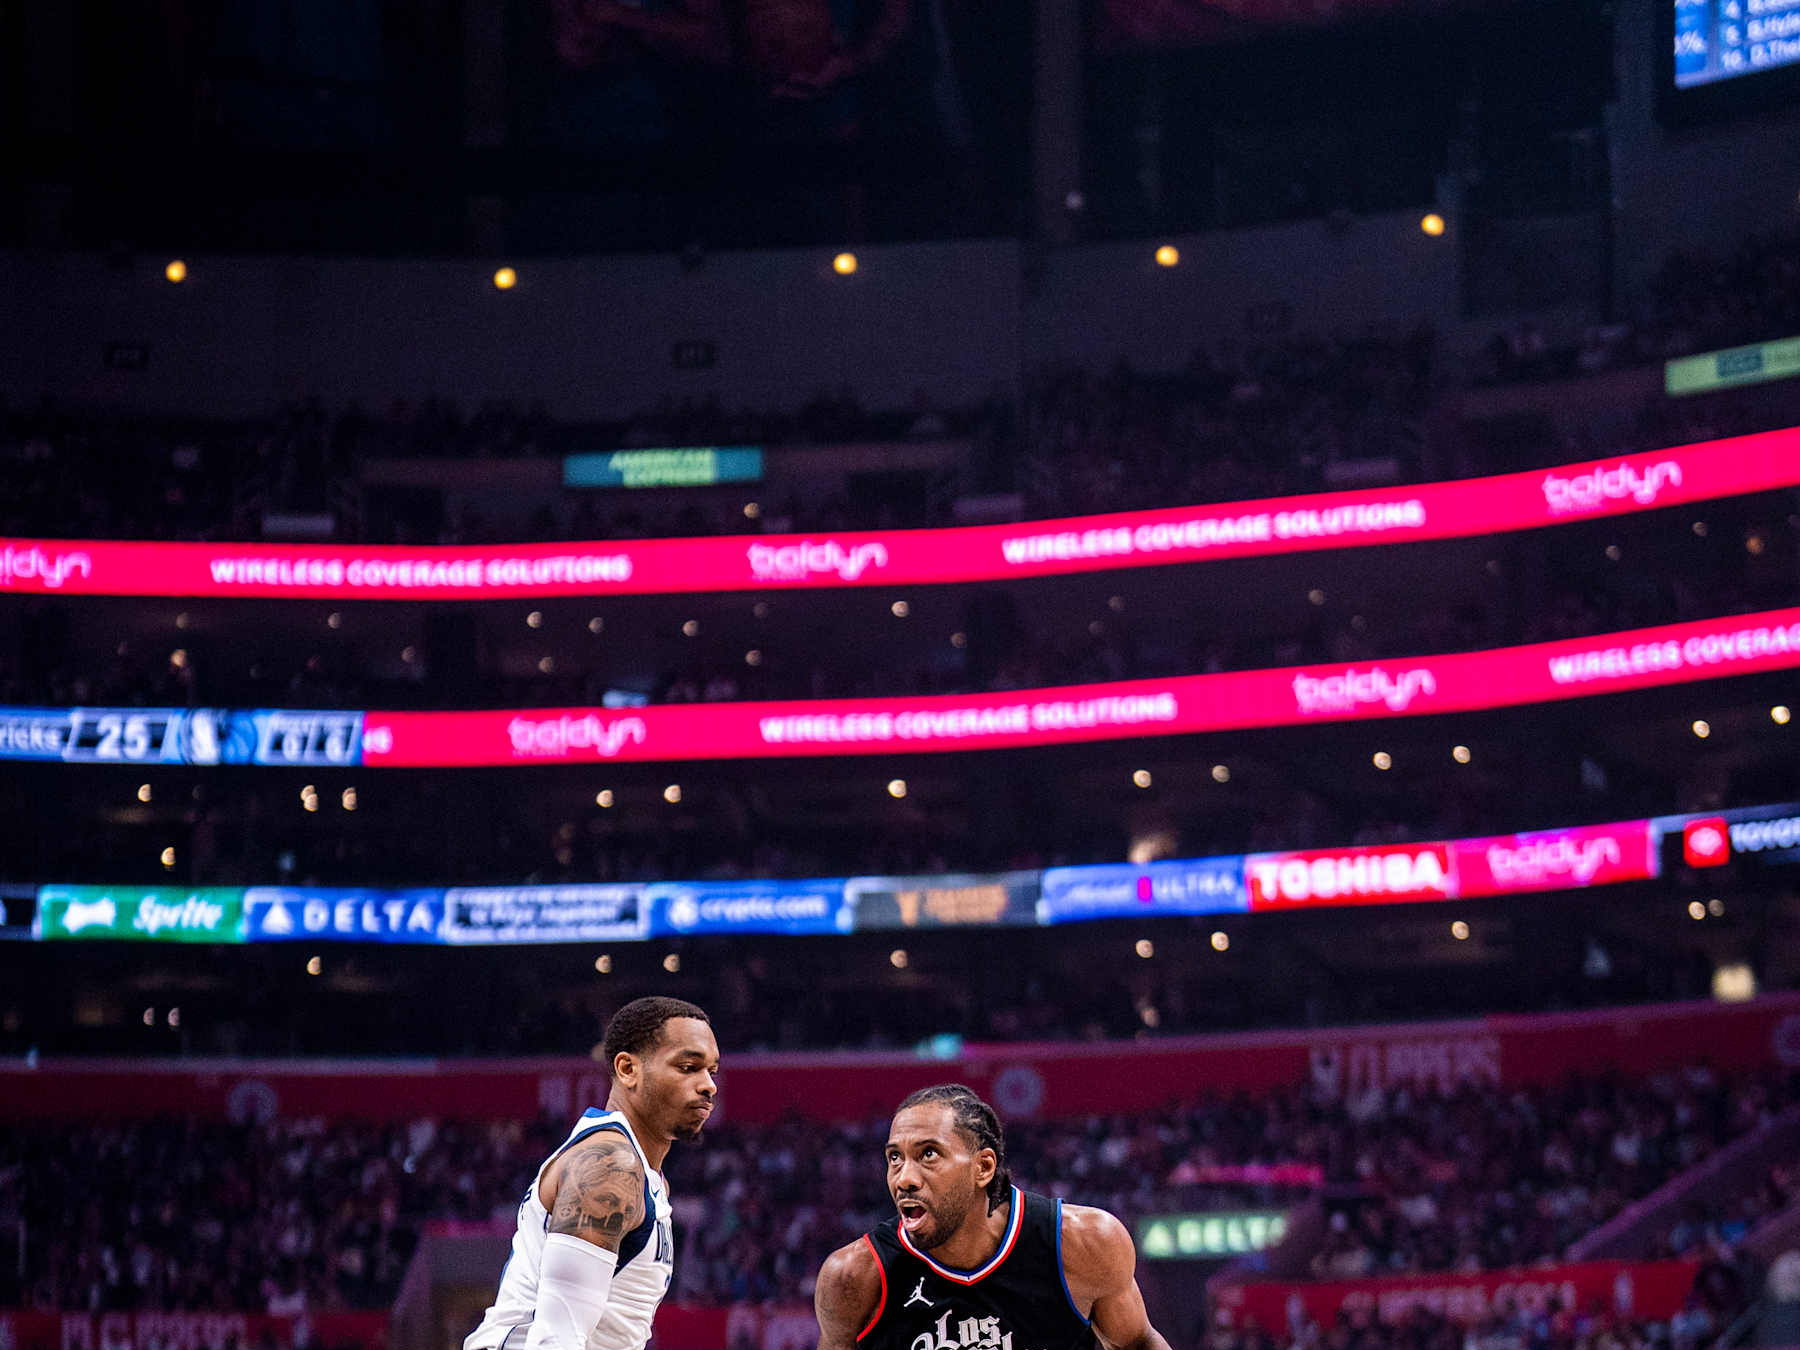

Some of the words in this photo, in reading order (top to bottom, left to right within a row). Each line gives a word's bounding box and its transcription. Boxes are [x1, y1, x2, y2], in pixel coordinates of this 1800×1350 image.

[1002, 527, 1132, 564] WIRELESS
[1134, 513, 1272, 551] COVERAGE
[1273, 499, 1426, 539] SOLUTIONS
[0, 544, 92, 588] ldyn
[210, 558, 345, 586] WIRELESS
[346, 558, 484, 587] COVERAGE
[485, 554, 633, 585] SOLUTIONS
[746, 540, 888, 581] boldyn
[1549, 640, 1683, 684] WIRELESS
[1292, 667, 1437, 711] boldyn
[97, 713, 150, 760] 25
[507, 713, 647, 757] boldyn
[759, 712, 895, 743] WIRELESS
[895, 704, 1029, 740] COVERAGE
[1031, 692, 1178, 730] SOLUTIONS
[1252, 851, 1443, 900] TOSHIBA
[133, 895, 224, 936] Sprite
[303, 898, 434, 934] DELTA
[700, 895, 829, 923] crypto.com
[934, 1309, 1002, 1350] Los
